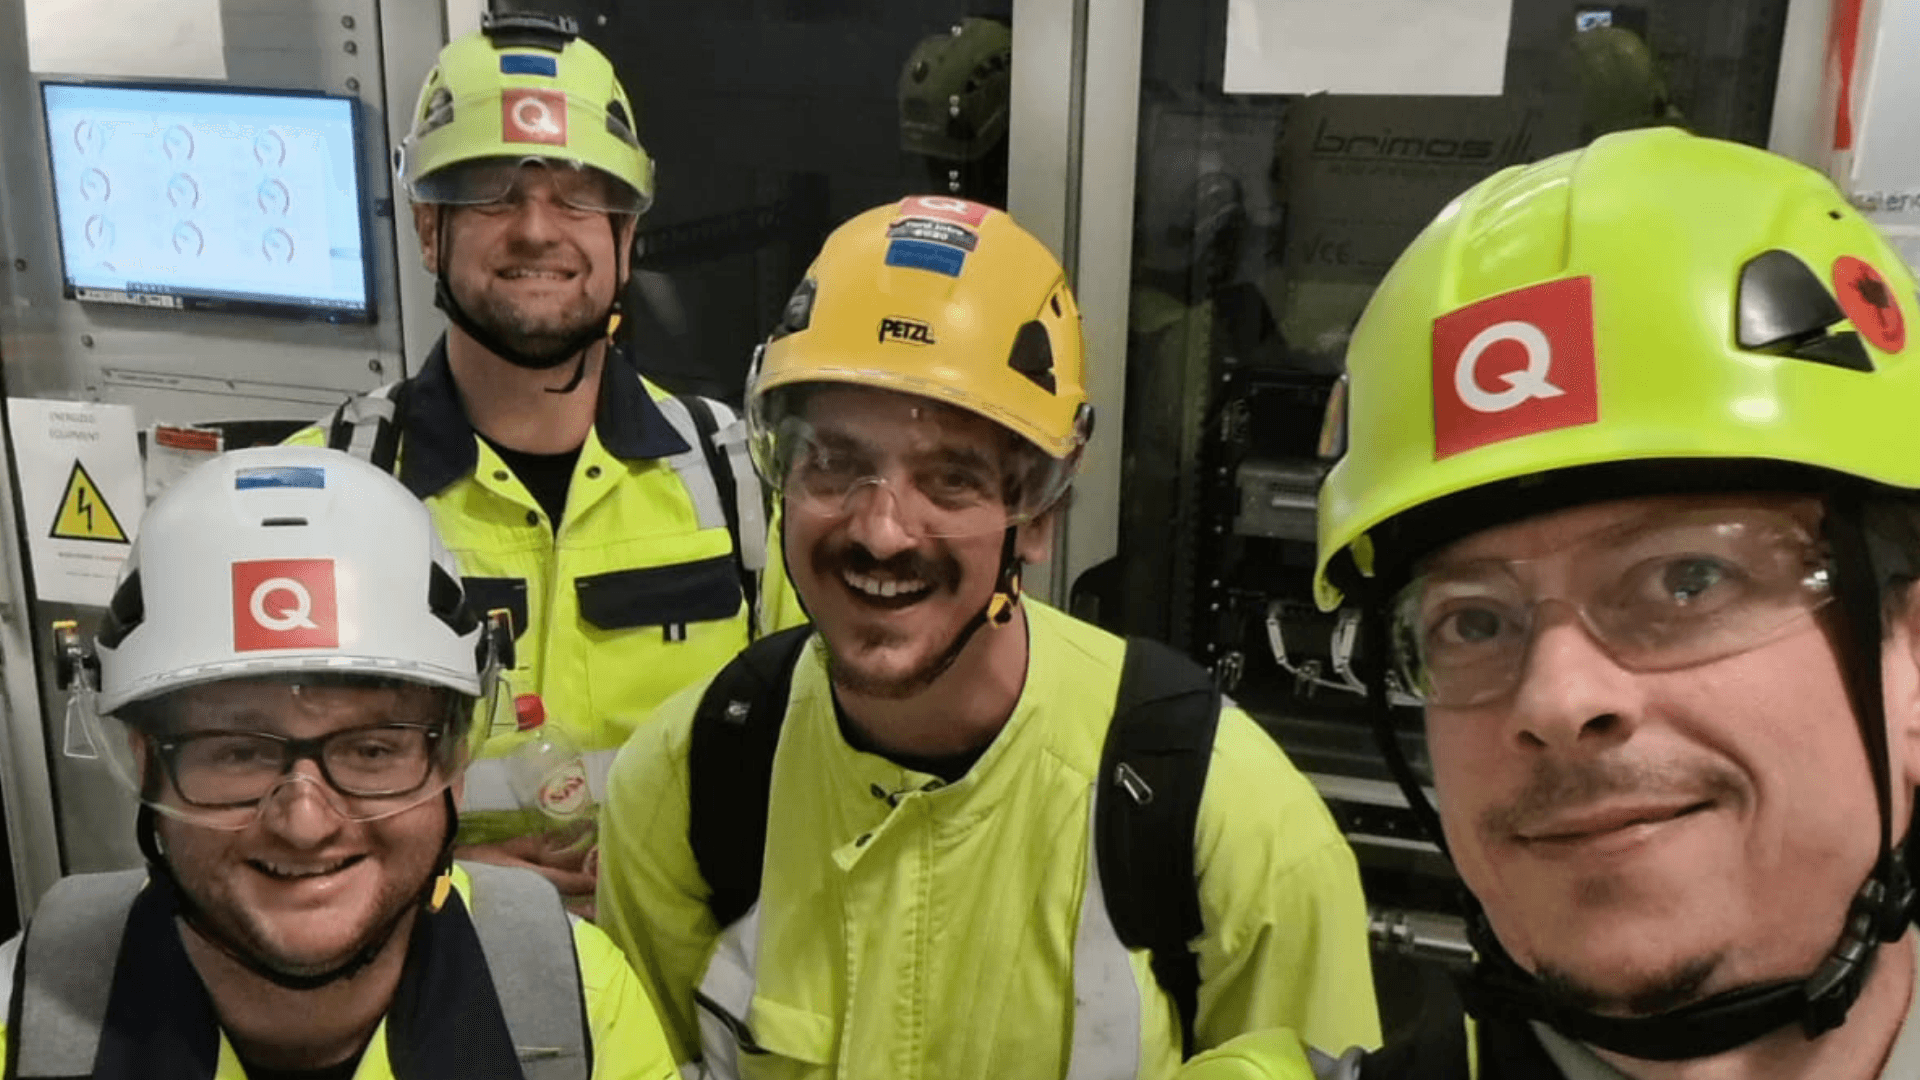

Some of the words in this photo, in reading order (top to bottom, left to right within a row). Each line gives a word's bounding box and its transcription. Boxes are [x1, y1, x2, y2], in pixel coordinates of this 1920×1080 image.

[511, 96, 561, 134] Q
[1312, 117, 1494, 160] brimos
[879, 318, 935, 344] PETZL
[1454, 320, 1567, 413] Q
[249, 577, 320, 632] Q
